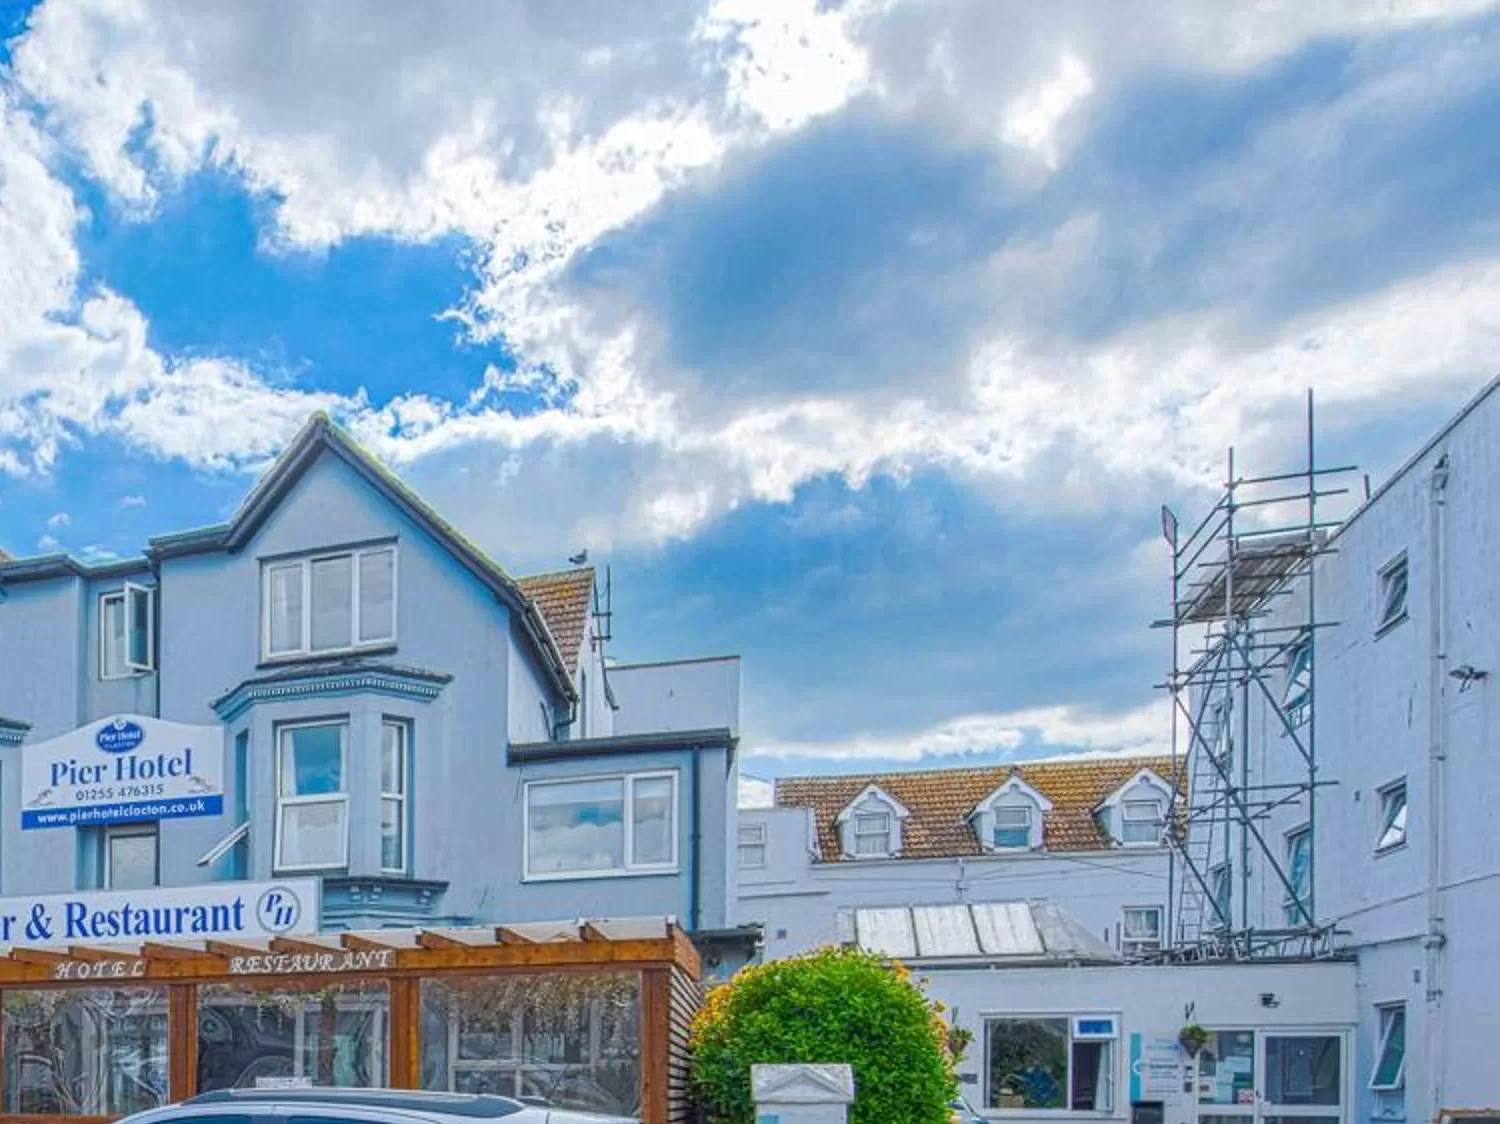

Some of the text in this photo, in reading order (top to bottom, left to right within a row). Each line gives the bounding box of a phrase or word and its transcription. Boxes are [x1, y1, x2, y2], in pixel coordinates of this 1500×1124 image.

[51, 748, 192, 787] Pier Hotel
[75, 784, 165, 801] 01255 476315
[37, 800, 205, 825] www.pierhotelclacton.co.uk
[25, 903, 53, 939] &
[65, 895, 245, 939] Restaurant
[55, 961, 145, 979] HOTEL
[230, 949, 393, 974] RESTAURANT
